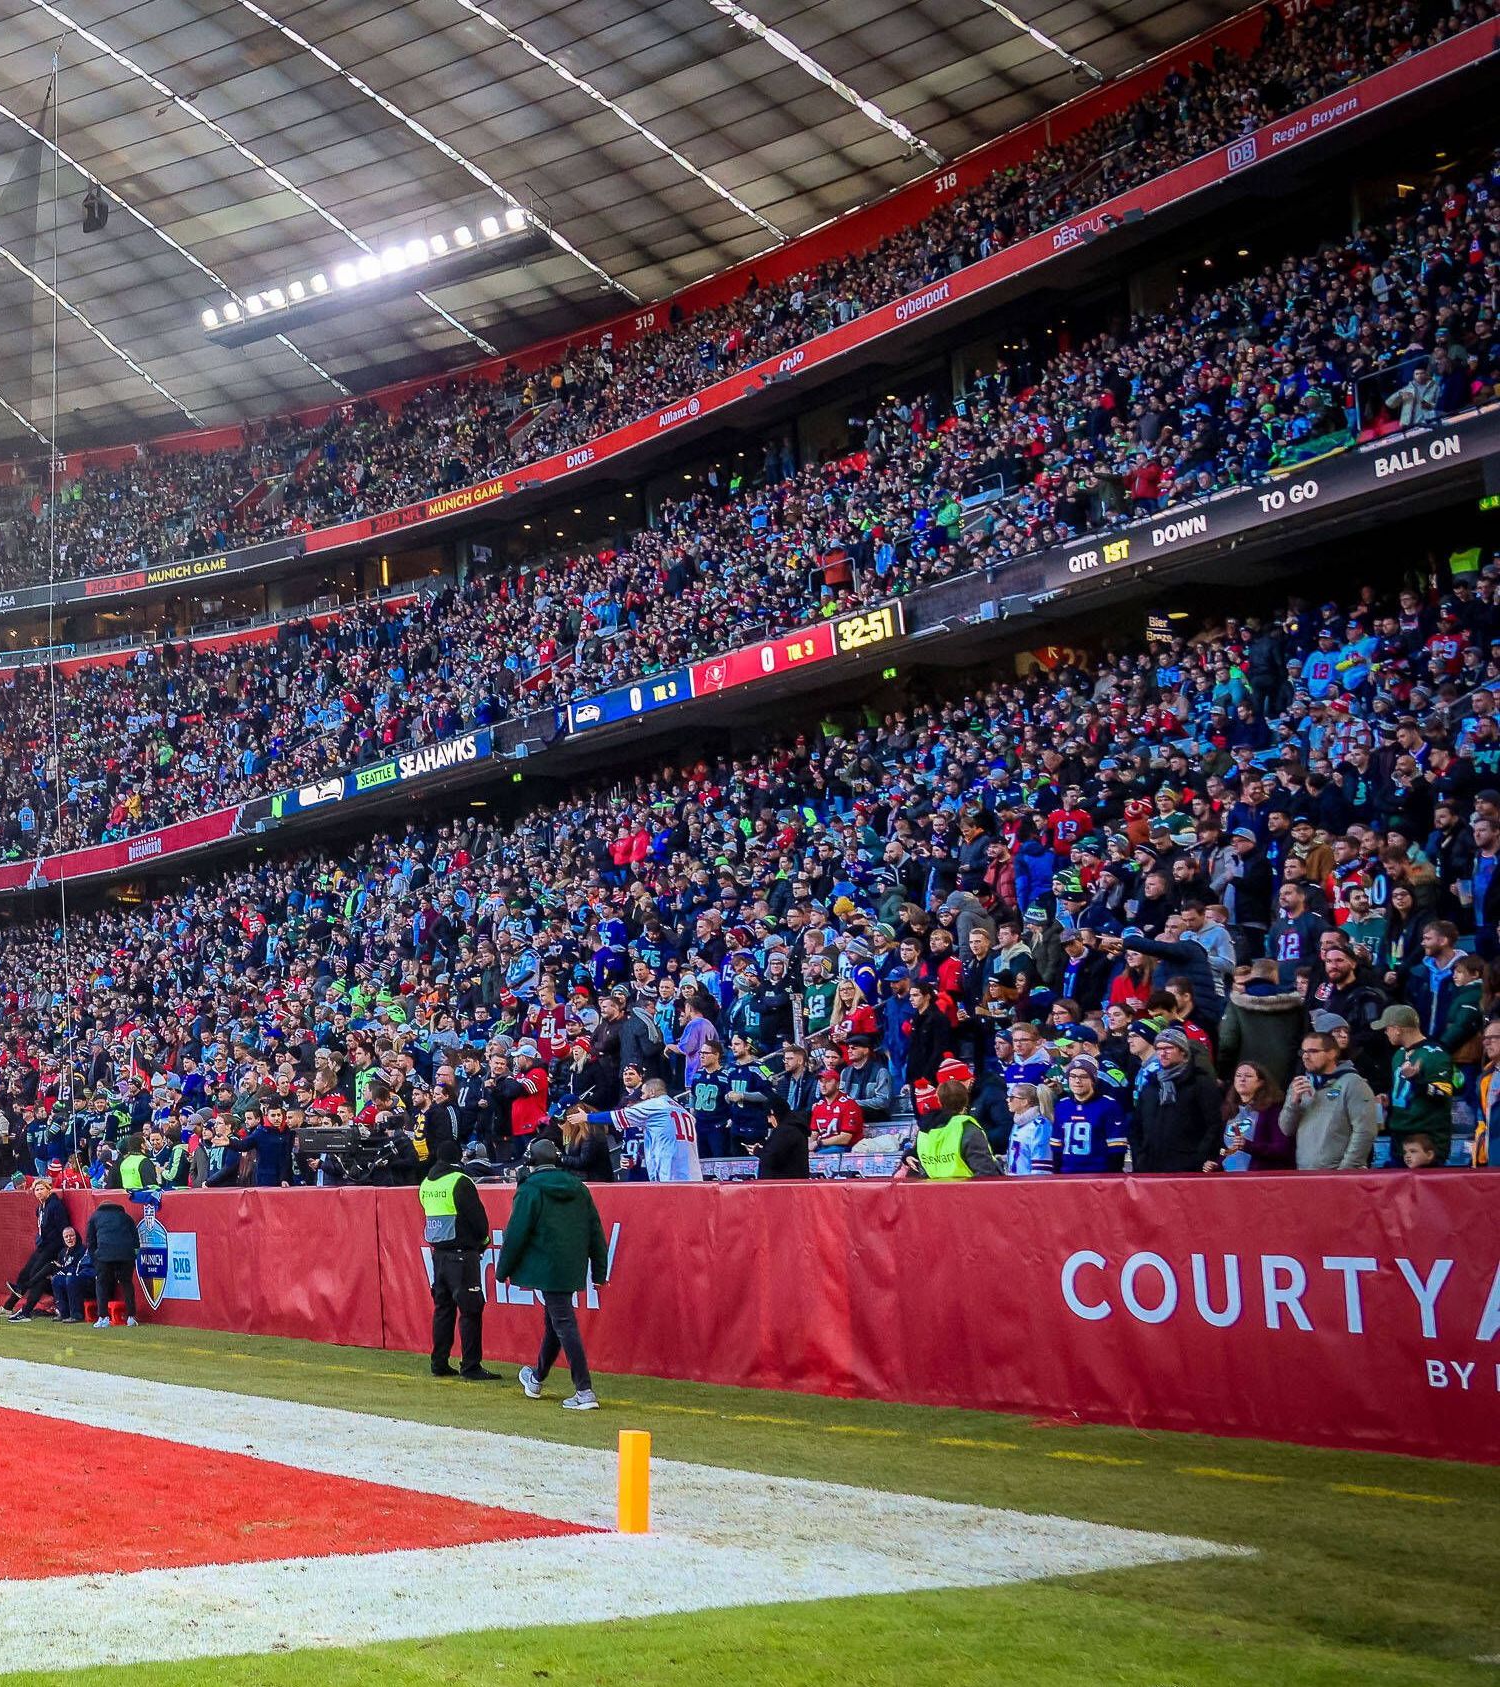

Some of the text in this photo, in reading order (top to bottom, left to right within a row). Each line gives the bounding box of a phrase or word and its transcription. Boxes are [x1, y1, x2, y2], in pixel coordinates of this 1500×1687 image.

[1272, 97, 1357, 145] Regio Bayern
[1229, 139, 1255, 168] DB
[935, 173, 957, 193] 318
[896, 283, 950, 319] cyberport
[635, 313, 655, 331] 319
[779, 350, 804, 372] Chio
[659, 406, 687, 427] Allianz
[566, 451, 587, 469] DKB
[1375, 435, 1461, 478] BALL ON
[374, 513, 399, 531] 2022
[428, 491, 473, 516] MUNICH
[474, 481, 503, 501] GAME
[1258, 480, 1318, 513] TO GO
[1152, 515, 1206, 547] DOWN
[1068, 539, 1130, 573] QTR 1ST
[90, 580, 117, 593] 2022
[148, 564, 191, 583] MUNICH
[194, 557, 227, 574] GAME
[1148, 616, 1168, 629] Bier
[760, 646, 775, 672] 0
[805, 639, 814, 656] 3
[629, 687, 643, 712] 0
[668, 681, 677, 697] 3
[361, 736, 477, 787] SEATTLE SEAHAWKS
[128, 838, 162, 862] BUCCANEERS
[1277, 933, 1300, 961] 12
[808, 995, 826, 1020] 12
[540, 1017, 555, 1038] 21
[57, 1085, 70, 1101] 12
[693, 1083, 717, 1112] 80
[670, 1110, 696, 1143] 10
[1063, 1121, 1092, 1156] 19
[140, 1254, 164, 1266] MUNICH
[172, 1257, 191, 1274] DKB
[1426, 1359, 1476, 1391] BY
